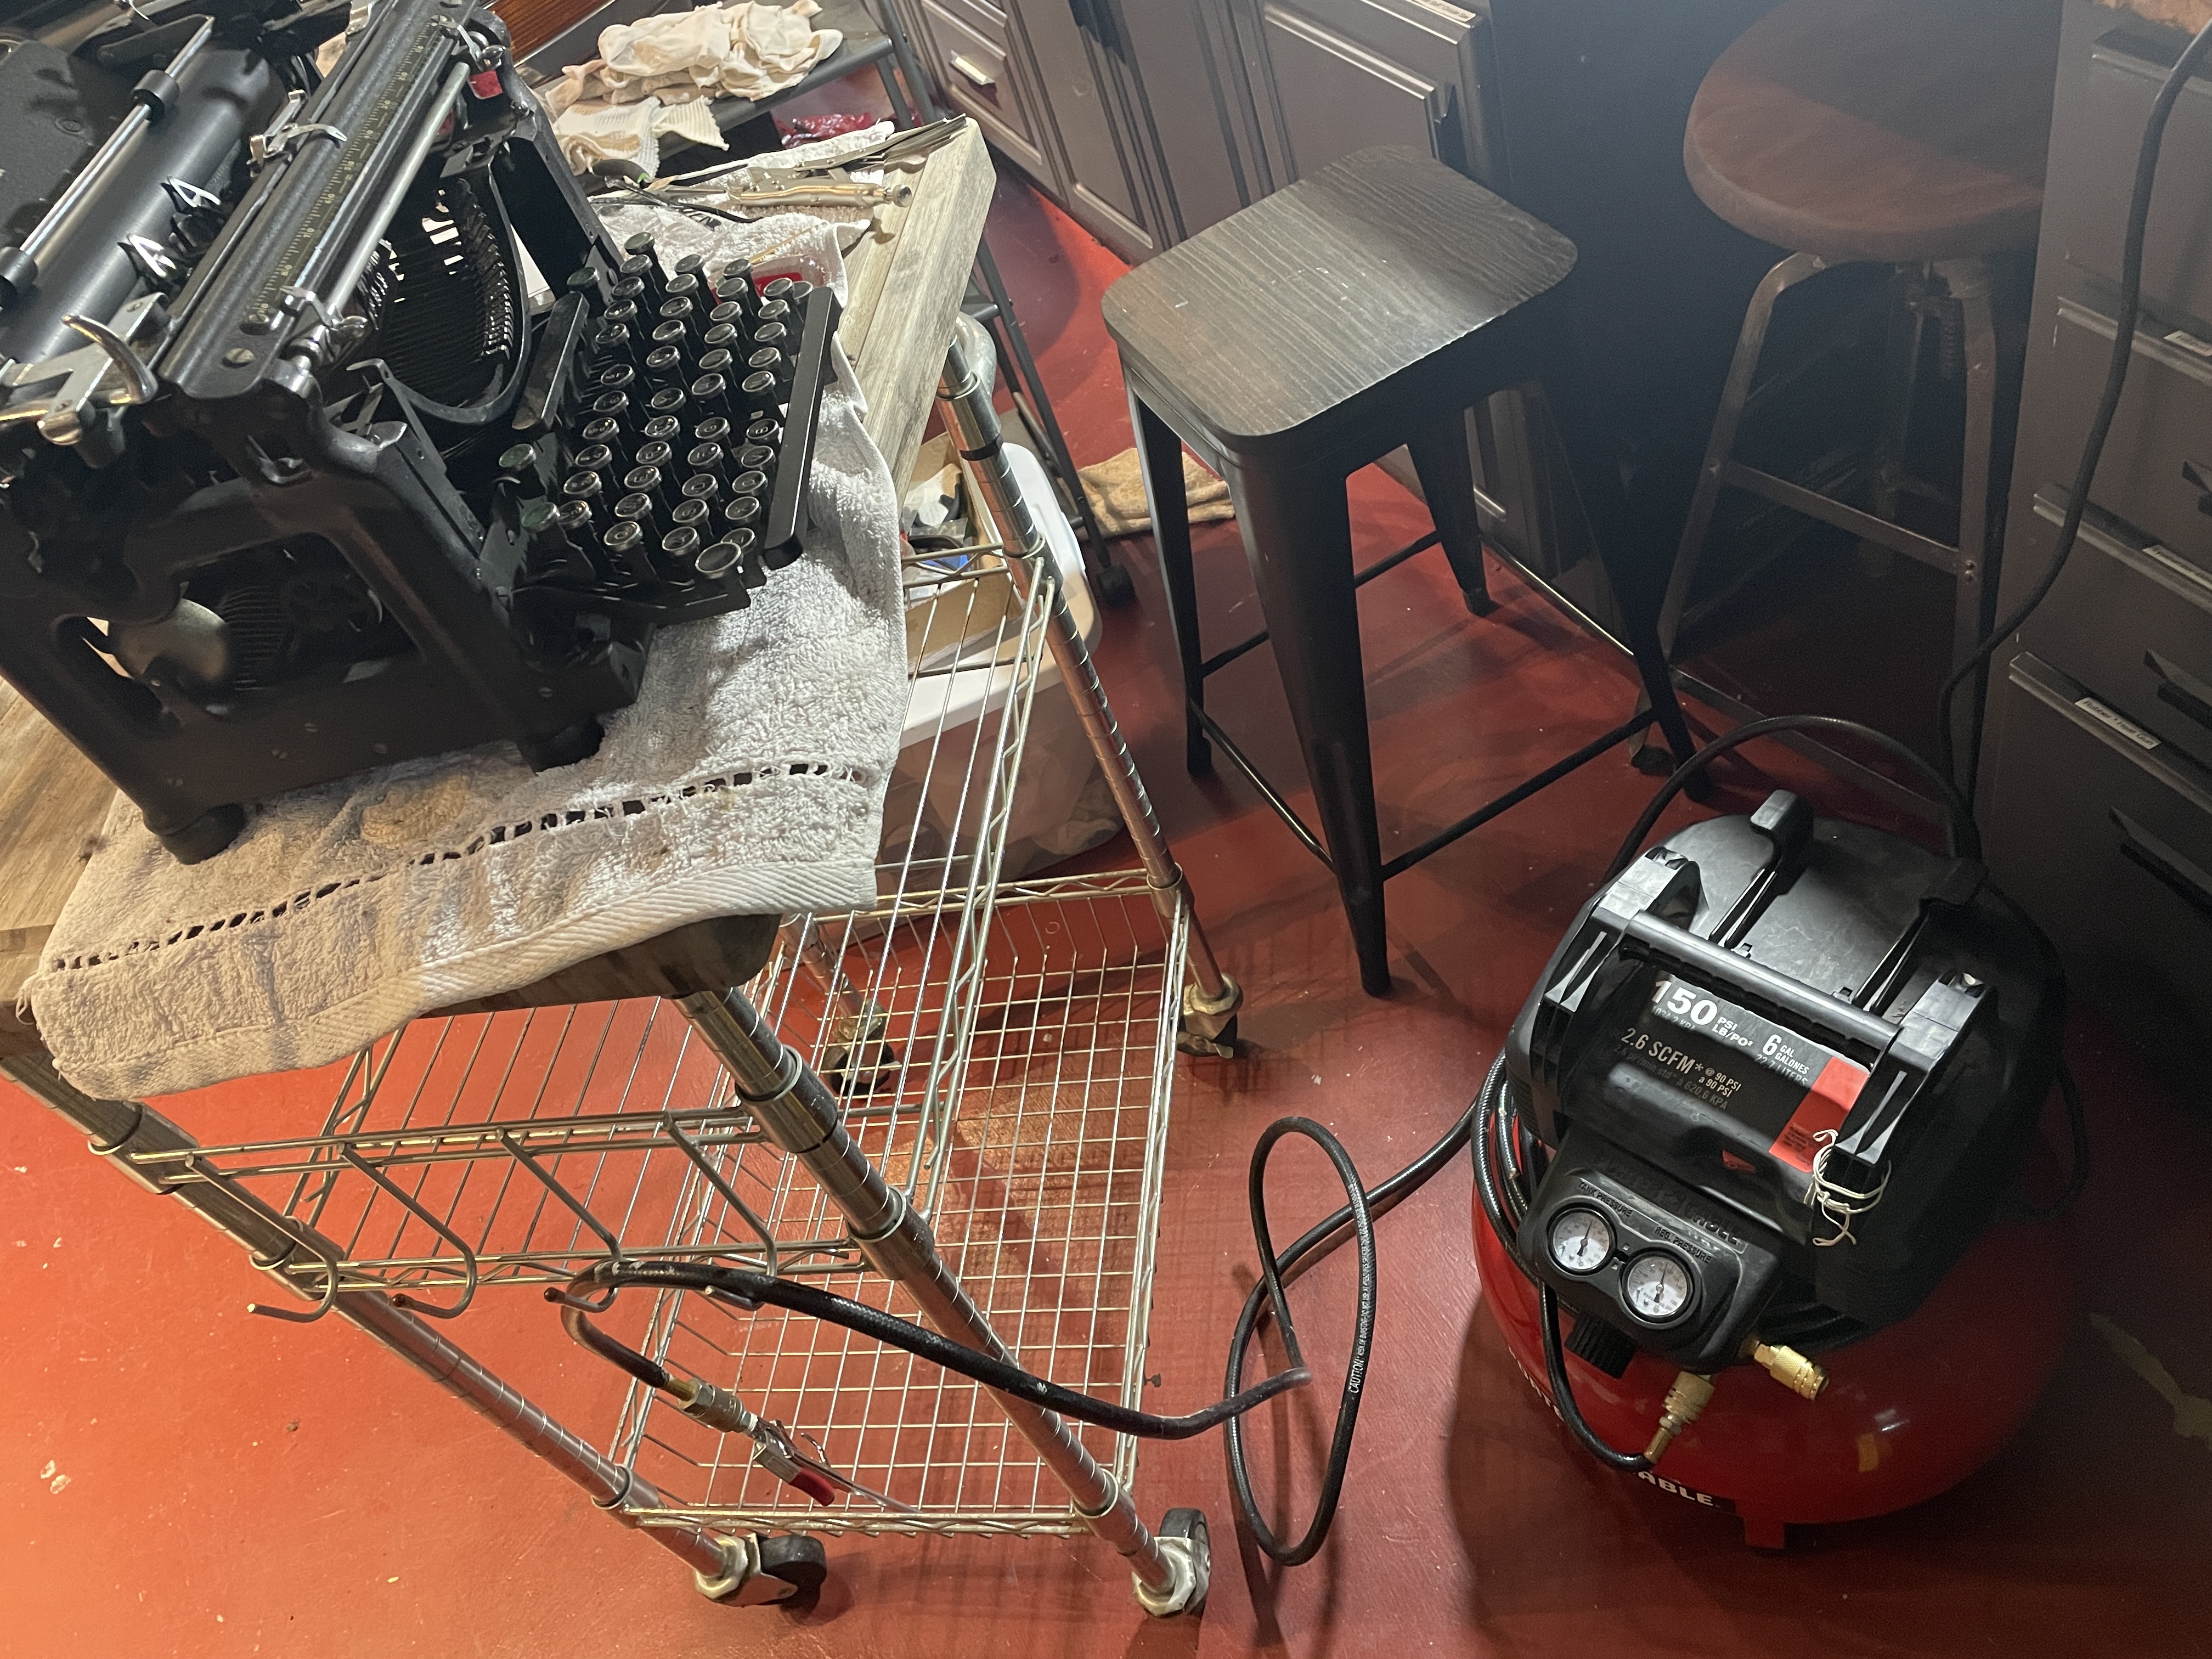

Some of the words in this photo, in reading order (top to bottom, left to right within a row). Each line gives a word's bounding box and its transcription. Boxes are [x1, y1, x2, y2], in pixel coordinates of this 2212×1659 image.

[1651, 980, 1718, 1025] 150
[1717, 1015, 1738, 1031] PSI
[1620, 1027, 1650, 1051] 2.6
[1762, 1034, 1782, 1056] 6
[1779, 1043, 1795, 1058] GAL
[1774, 1052, 1809, 1075] GALONES
[1703, 1066, 1716, 1078] @
[1714, 1071, 1727, 1084] 90
[1725, 1077, 1742, 1092] PSI
[1705, 1077, 1718, 1090] 90
[1716, 1084, 1733, 1098] PSI
[1708, 1094, 1728, 1110] KPA
[1577, 1180, 1597, 1196] TANK
[1596, 1191, 1633, 1217] PRESSURE
[1672, 1236, 1712, 1264] PRESSURE
[1638, 1471, 1713, 1505] ABLE
